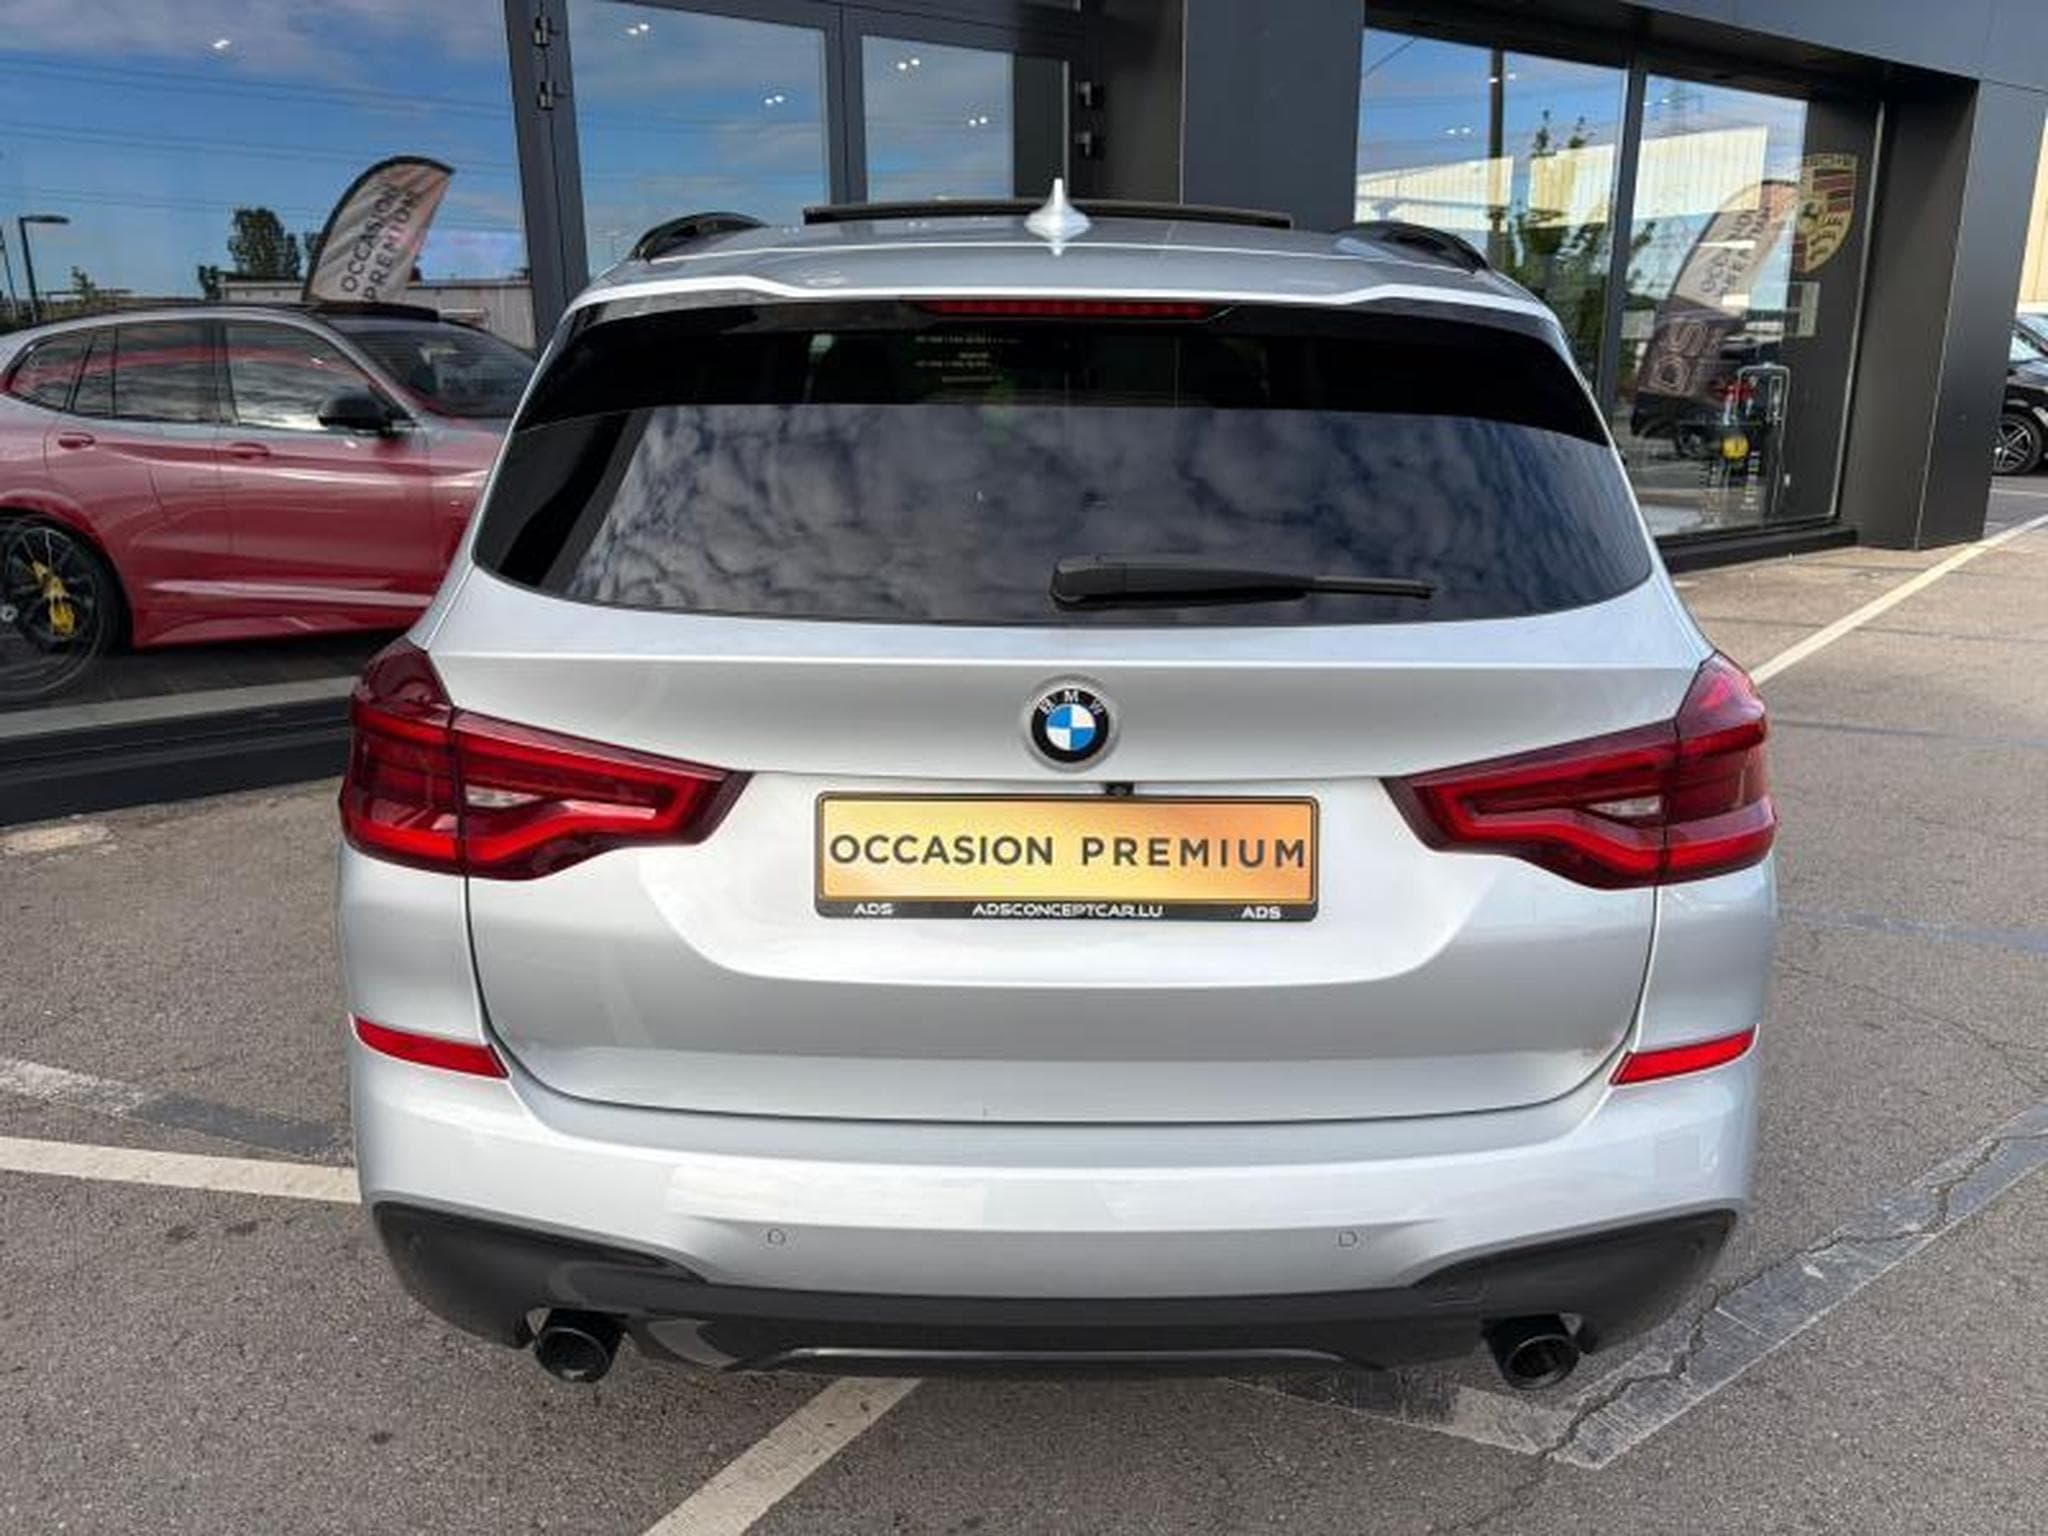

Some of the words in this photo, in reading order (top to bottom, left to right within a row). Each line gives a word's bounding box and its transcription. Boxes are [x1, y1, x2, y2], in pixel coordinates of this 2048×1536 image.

[340, 184, 401, 293] OCCASION
[1036, 690, 1105, 715] BMW
[830, 834, 1053, 865] OCCASION
[1082, 837, 1304, 868] PREMIUM
[853, 903, 894, 915] ADS
[1241, 906, 1282, 919] ADS
